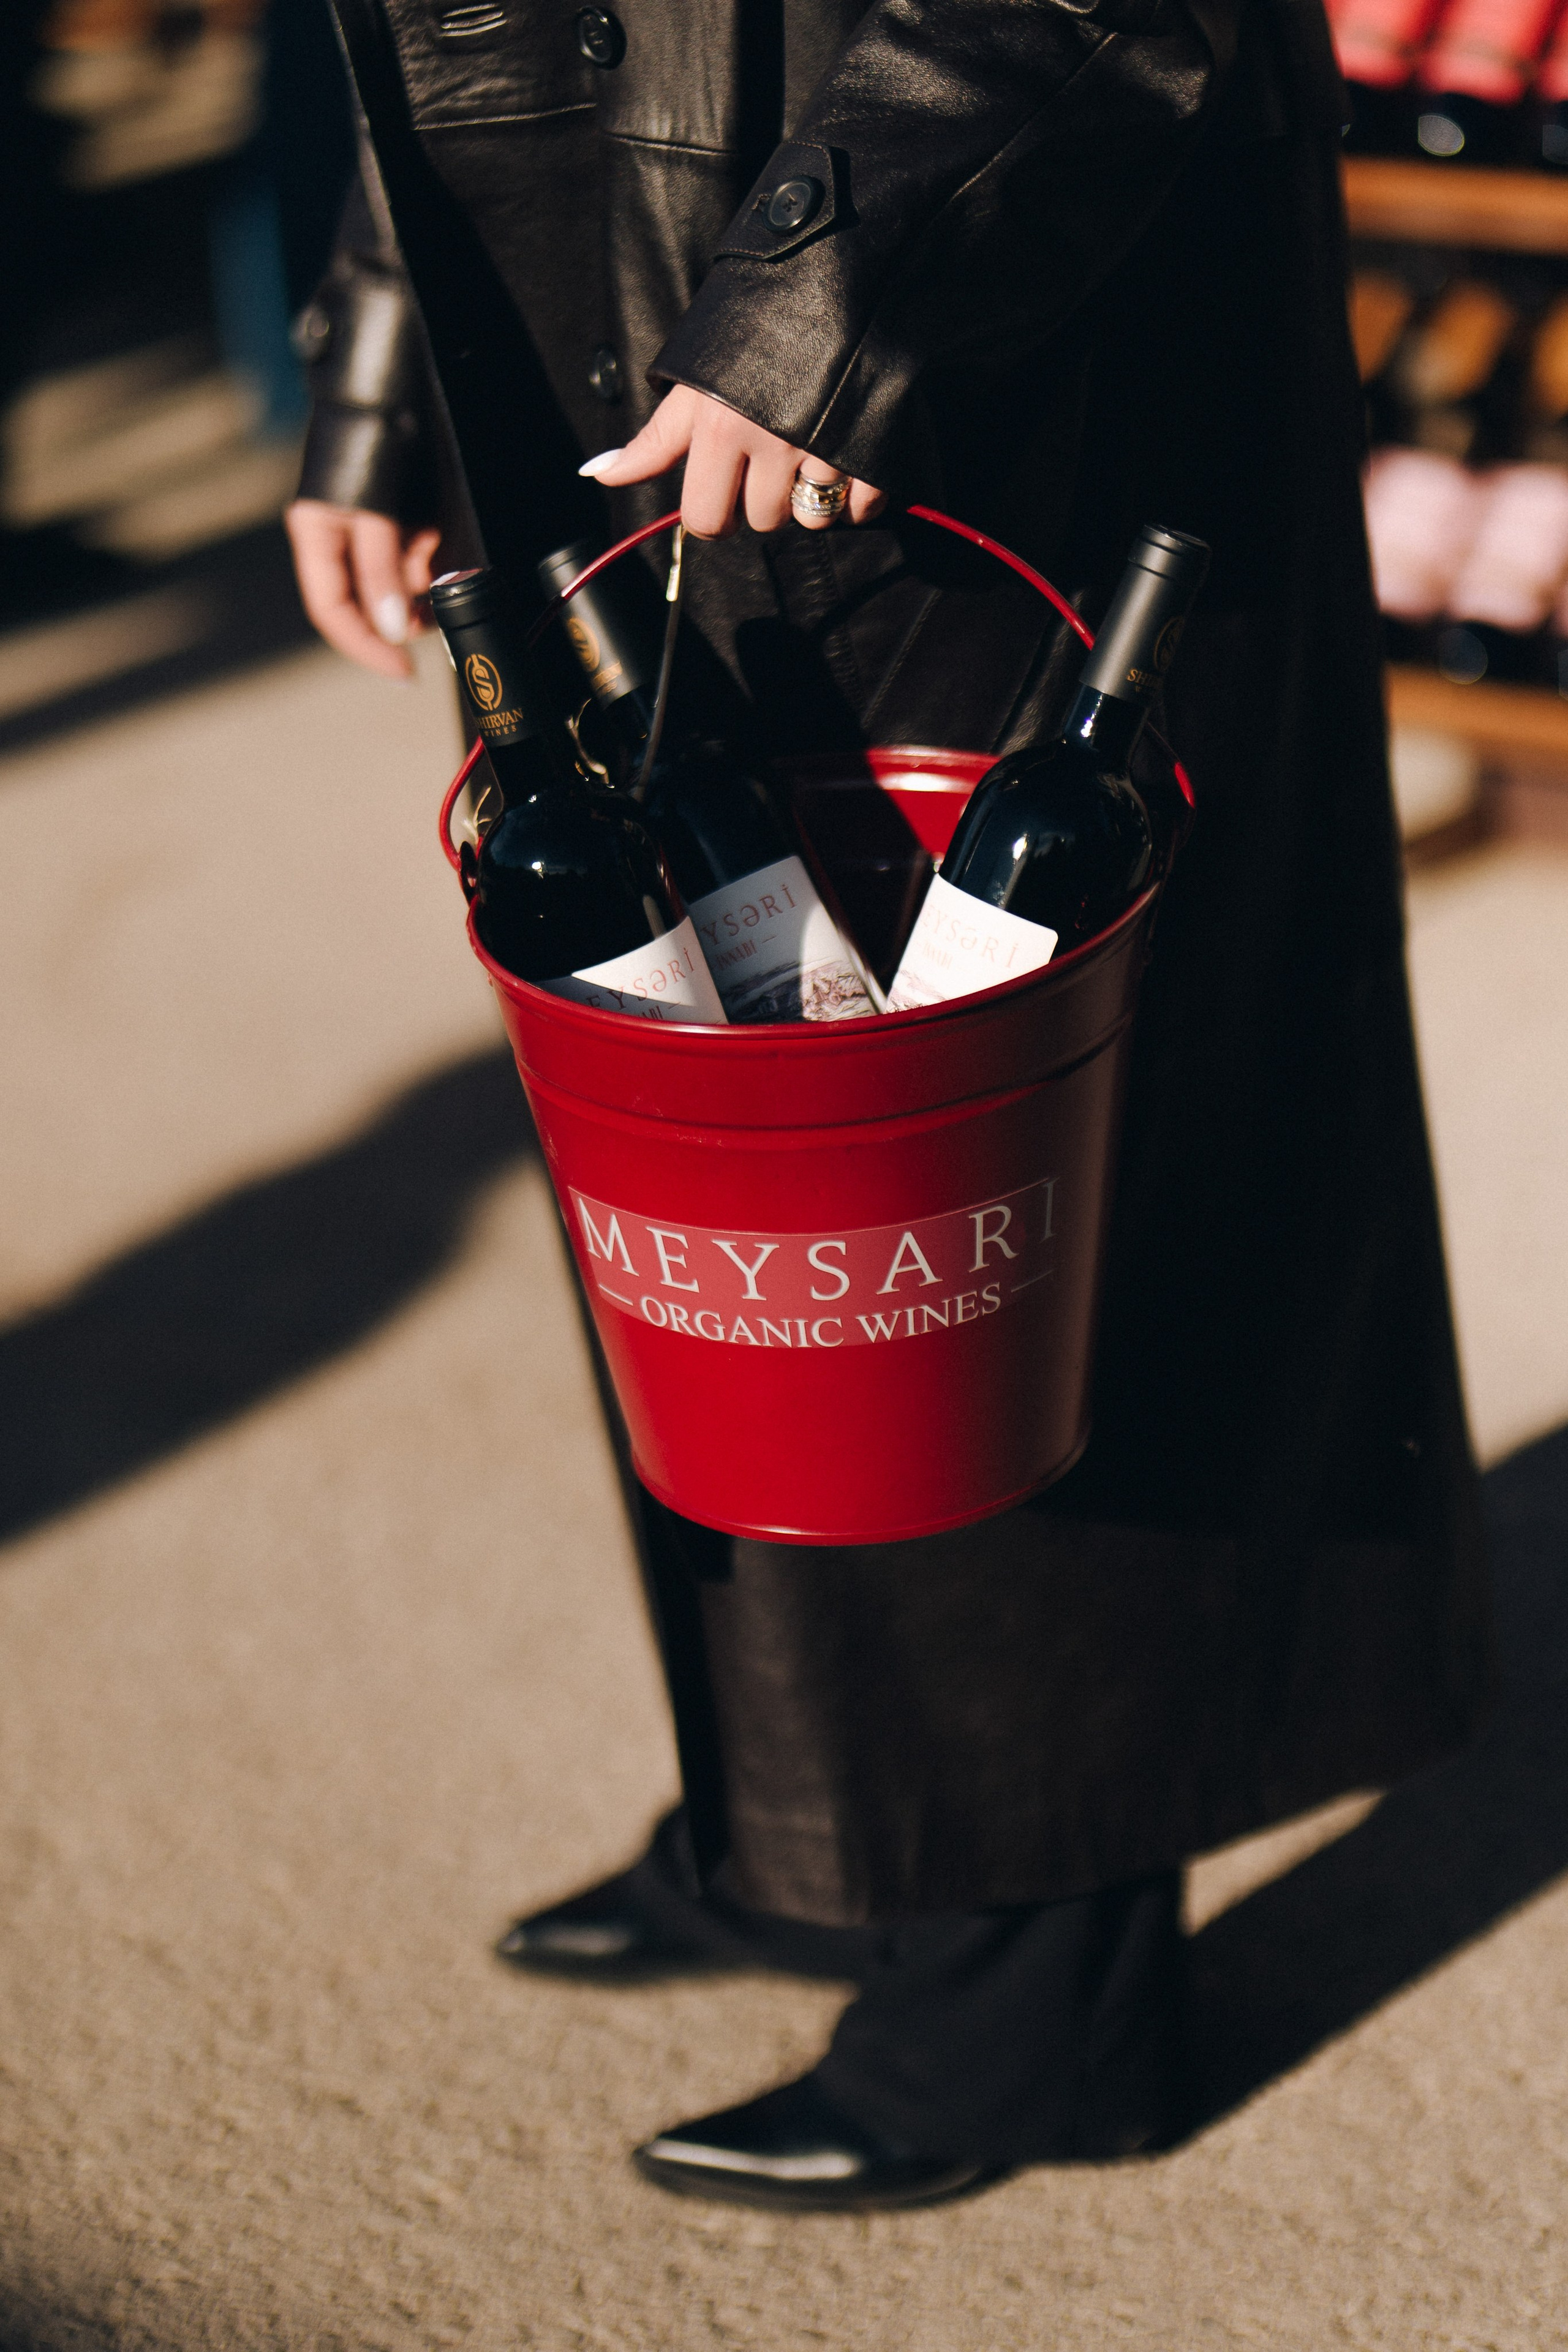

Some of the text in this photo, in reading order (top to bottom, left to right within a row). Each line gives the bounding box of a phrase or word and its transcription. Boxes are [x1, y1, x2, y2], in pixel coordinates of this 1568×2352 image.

[577, 1176, 1060, 1302] MEYSARI
[640, 1281, 1002, 1348] ORGANIC WINES
